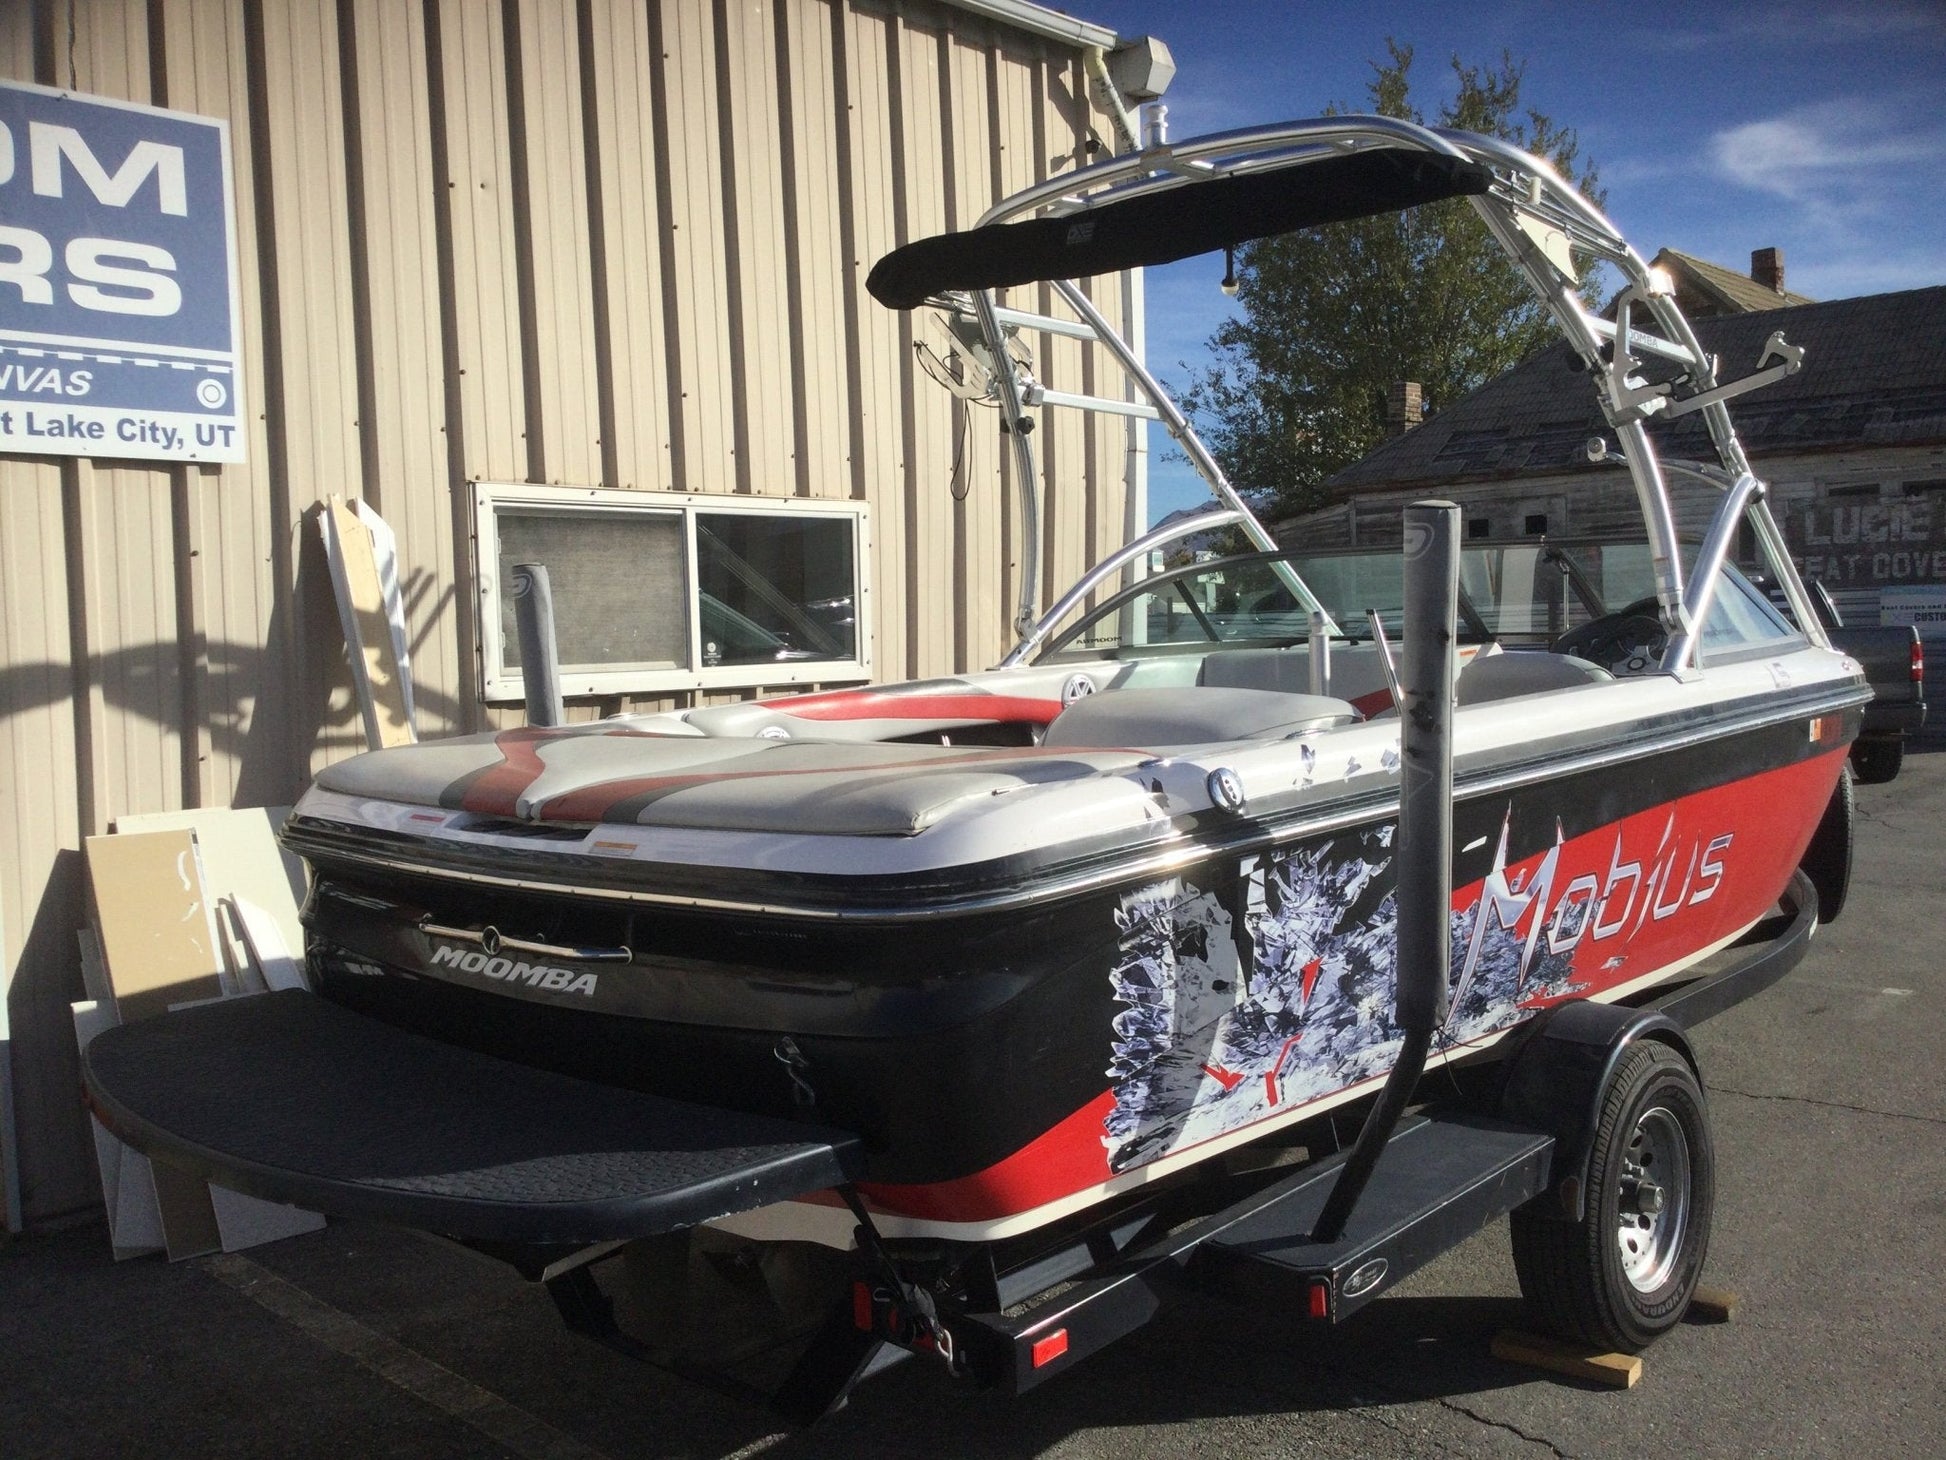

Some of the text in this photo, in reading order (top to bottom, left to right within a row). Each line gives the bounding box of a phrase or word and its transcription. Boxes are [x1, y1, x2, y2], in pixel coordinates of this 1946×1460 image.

[0, 119, 188, 217] M
[26, 411, 105, 440] Lake
[117, 418, 184, 450] City,
[195, 423, 236, 448] UT
[430, 945, 598, 996] MOOMBA
